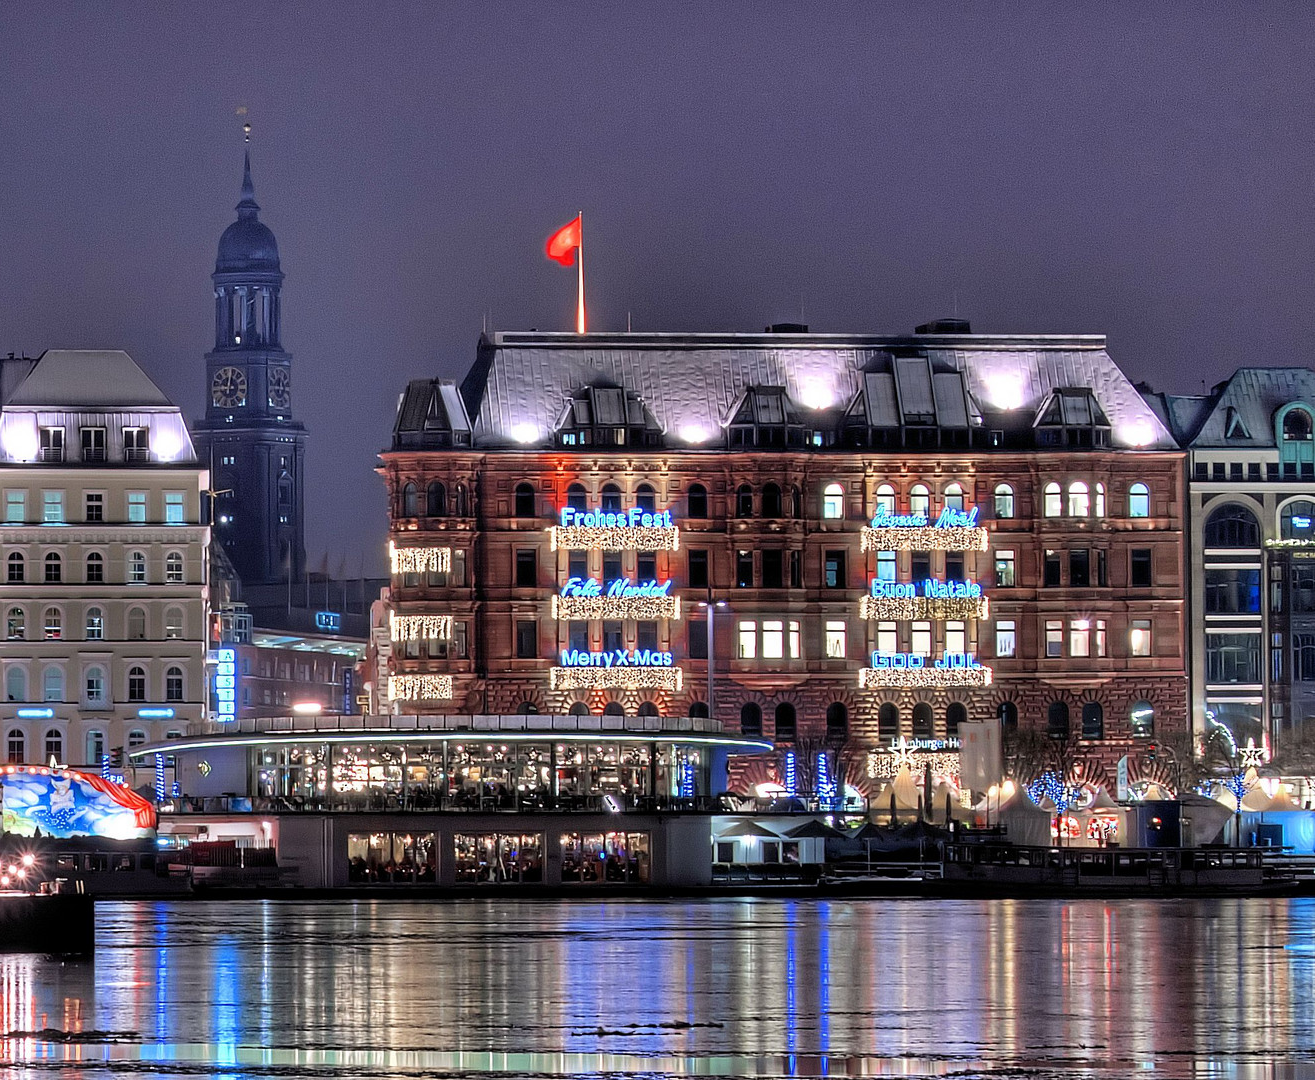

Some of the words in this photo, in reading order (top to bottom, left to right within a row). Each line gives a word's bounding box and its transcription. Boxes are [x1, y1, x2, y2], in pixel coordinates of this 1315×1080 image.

[561, 507, 627, 528] Frohes
[629, 507, 673, 528] Fest
[561, 577, 602, 598] Feliz
[608, 578, 671, 598] Navidad
[871, 578, 916, 599] Buon
[925, 578, 981, 599] Natale
[561, 650, 614, 668] Merry
[615, 650, 672, 666] X-Mas
[934, 650, 981, 669] JUL
